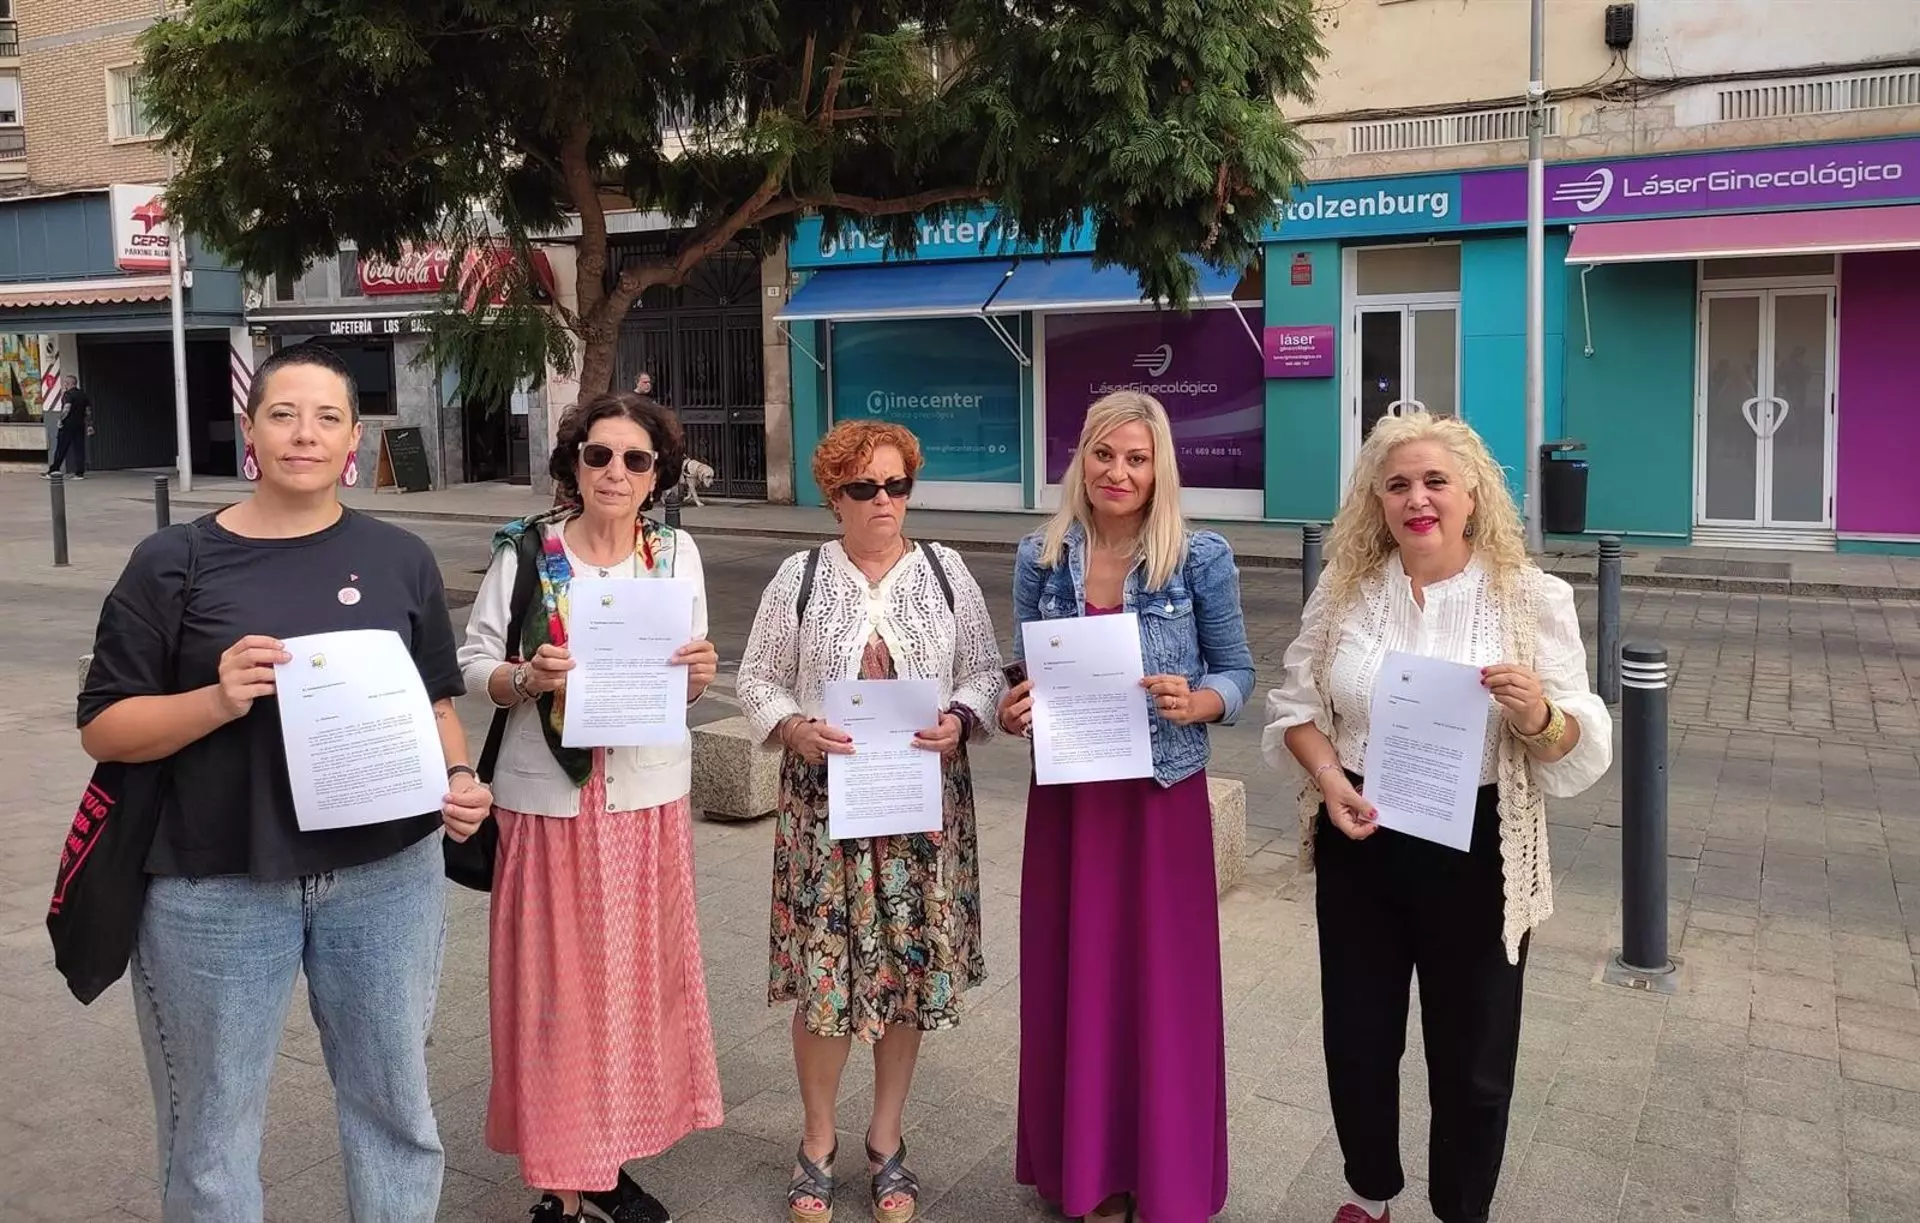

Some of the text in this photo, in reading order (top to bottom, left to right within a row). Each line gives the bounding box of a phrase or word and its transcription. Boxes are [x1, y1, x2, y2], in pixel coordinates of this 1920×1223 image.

[1622, 161, 1903, 199] LáserGinecológico
[330, 319, 372, 334] CAFETERÍA
[383, 319, 399, 333] LOS
[1280, 333, 1315, 346] láser
